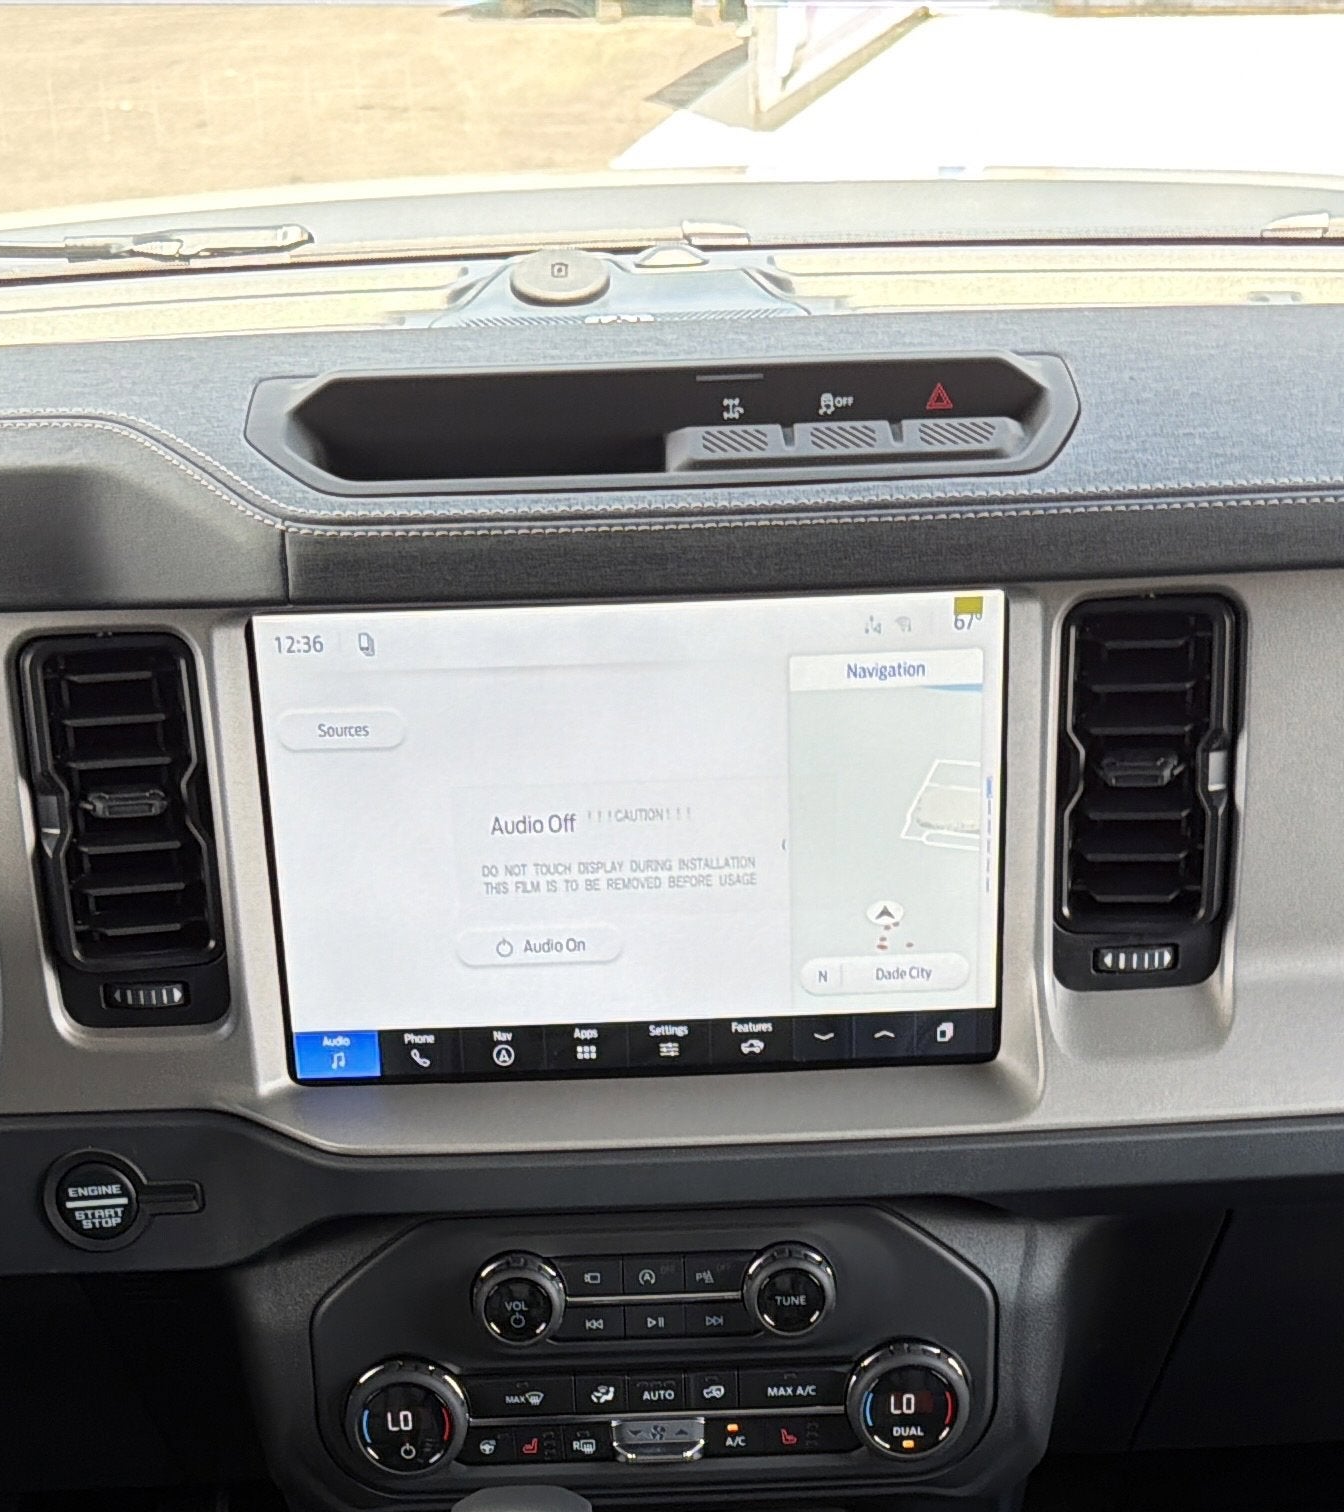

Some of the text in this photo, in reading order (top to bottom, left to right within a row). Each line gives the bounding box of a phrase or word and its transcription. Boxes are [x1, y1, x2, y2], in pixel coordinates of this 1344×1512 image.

[835, 396, 854, 407] OFF
[274, 635, 324, 654] 12:36
[846, 662, 926, 681] Navigation
[317, 723, 370, 738] Sources
[491, 814, 577, 835] Audio Off
[482, 855, 756, 877] DO NOT TOUCH DISPLAY DURING INSTALLATION
[484, 872, 757, 895] THIS FILM IS TO BE REMOVED BEFORE USAGE
[523, 937, 586, 954] Audio On
[818, 970, 828, 982] N
[875, 967, 932, 982] Dade City
[649, 1025, 689, 1037] Settings
[731, 1022, 773, 1033] Features
[404, 1033, 435, 1045] Phone
[493, 1030, 513, 1042] Nav
[573, 1028, 598, 1040] Apps
[322, 1035, 351, 1048] Audio
[68, 1184, 122, 1198] ENGINE
[75, 1208, 124, 1221] START
[82, 1217, 121, 1229] STOP
[505, 1301, 528, 1311] VOL
[775, 1295, 806, 1306] TUNE
[642, 1390, 675, 1401] AUTO
[768, 1384, 816, 1397] MAX A/C
[506, 1395, 526, 1404] MAX
[890, 1393, 915, 1415] LO
[387, 1411, 413, 1431] LO
[893, 1426, 924, 1437] DUAL
[725, 1436, 746, 1447] A/C
